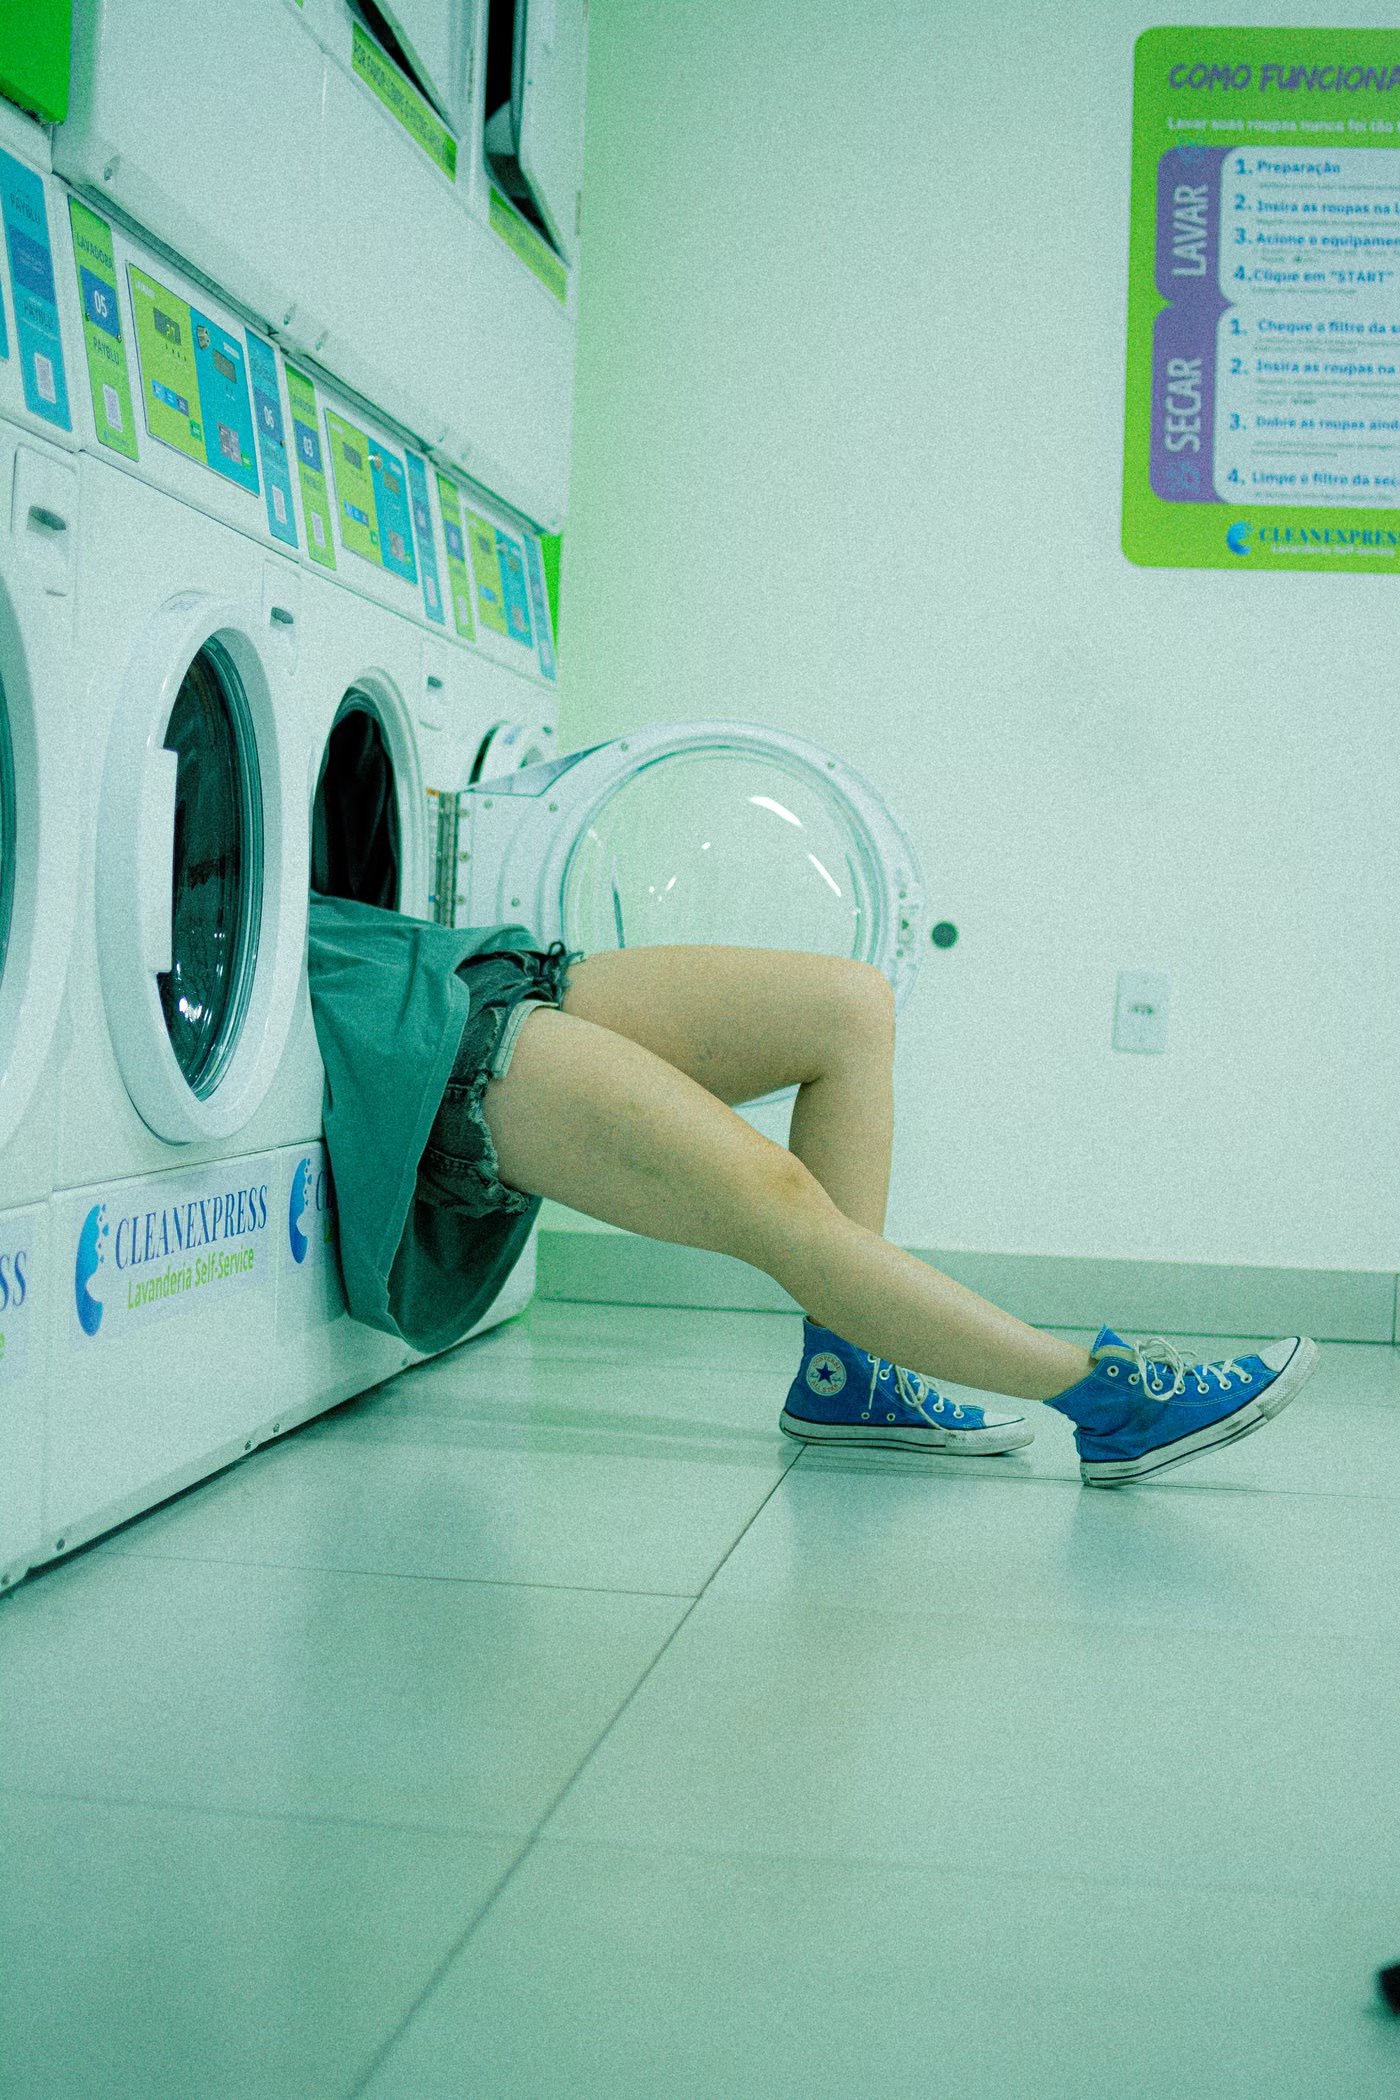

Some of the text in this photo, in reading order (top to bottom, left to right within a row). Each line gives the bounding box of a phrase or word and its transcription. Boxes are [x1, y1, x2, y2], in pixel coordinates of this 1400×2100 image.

[1168, 63, 1251, 90] COMO
[1234, 157, 1341, 176] 1. Preparação
[1234, 193, 1252, 212] 2.
[1257, 200, 1298, 213] Insira
[1303, 203, 1318, 213] as
[1322, 203, 1369, 215] roupas
[1373, 204, 1391, 214] na
[1171, 184, 1209, 277] LAVAR
[1234, 227, 1252, 245] 3.
[1256, 232, 1305, 246] Acione
[1309, 236, 1318, 245] o
[76, 232, 114, 271] LAVADORA
[1254, 268, 1299, 284] Clique
[1304, 271, 1326, 282] em
[94, 289, 108, 319] 05
[1231, 317, 1248, 335] 1.
[1257, 319, 1312, 335] Cheque
[1328, 320, 1364, 333] filtro
[1368, 321, 1386, 334] da
[93, 335, 120, 366] PAYBLU
[1231, 357, 1249, 375] 2.
[1303, 362, 1319, 373] as
[1324, 363, 1374, 376] roupas
[1378, 365, 1395, 375] na
[1164, 357, 1203, 454] SECAR
[1229, 412, 1247, 430] 3.
[1300, 418, 1316, 429] as
[1319, 419, 1366, 431] roupas
[1228, 467, 1246, 485] 4.
[1252, 471, 1296, 486] Limpe
[1301, 475, 1310, 485] o
[1313, 472, 1350, 486] filtro
[1353, 474, 1370, 486] da
[1259, 528, 1400, 545] CLEANEXPRES
[114, 1184, 268, 1270] CLEANEXPRESS
[128, 1244, 254, 1310] Lavanderia Self-Service
